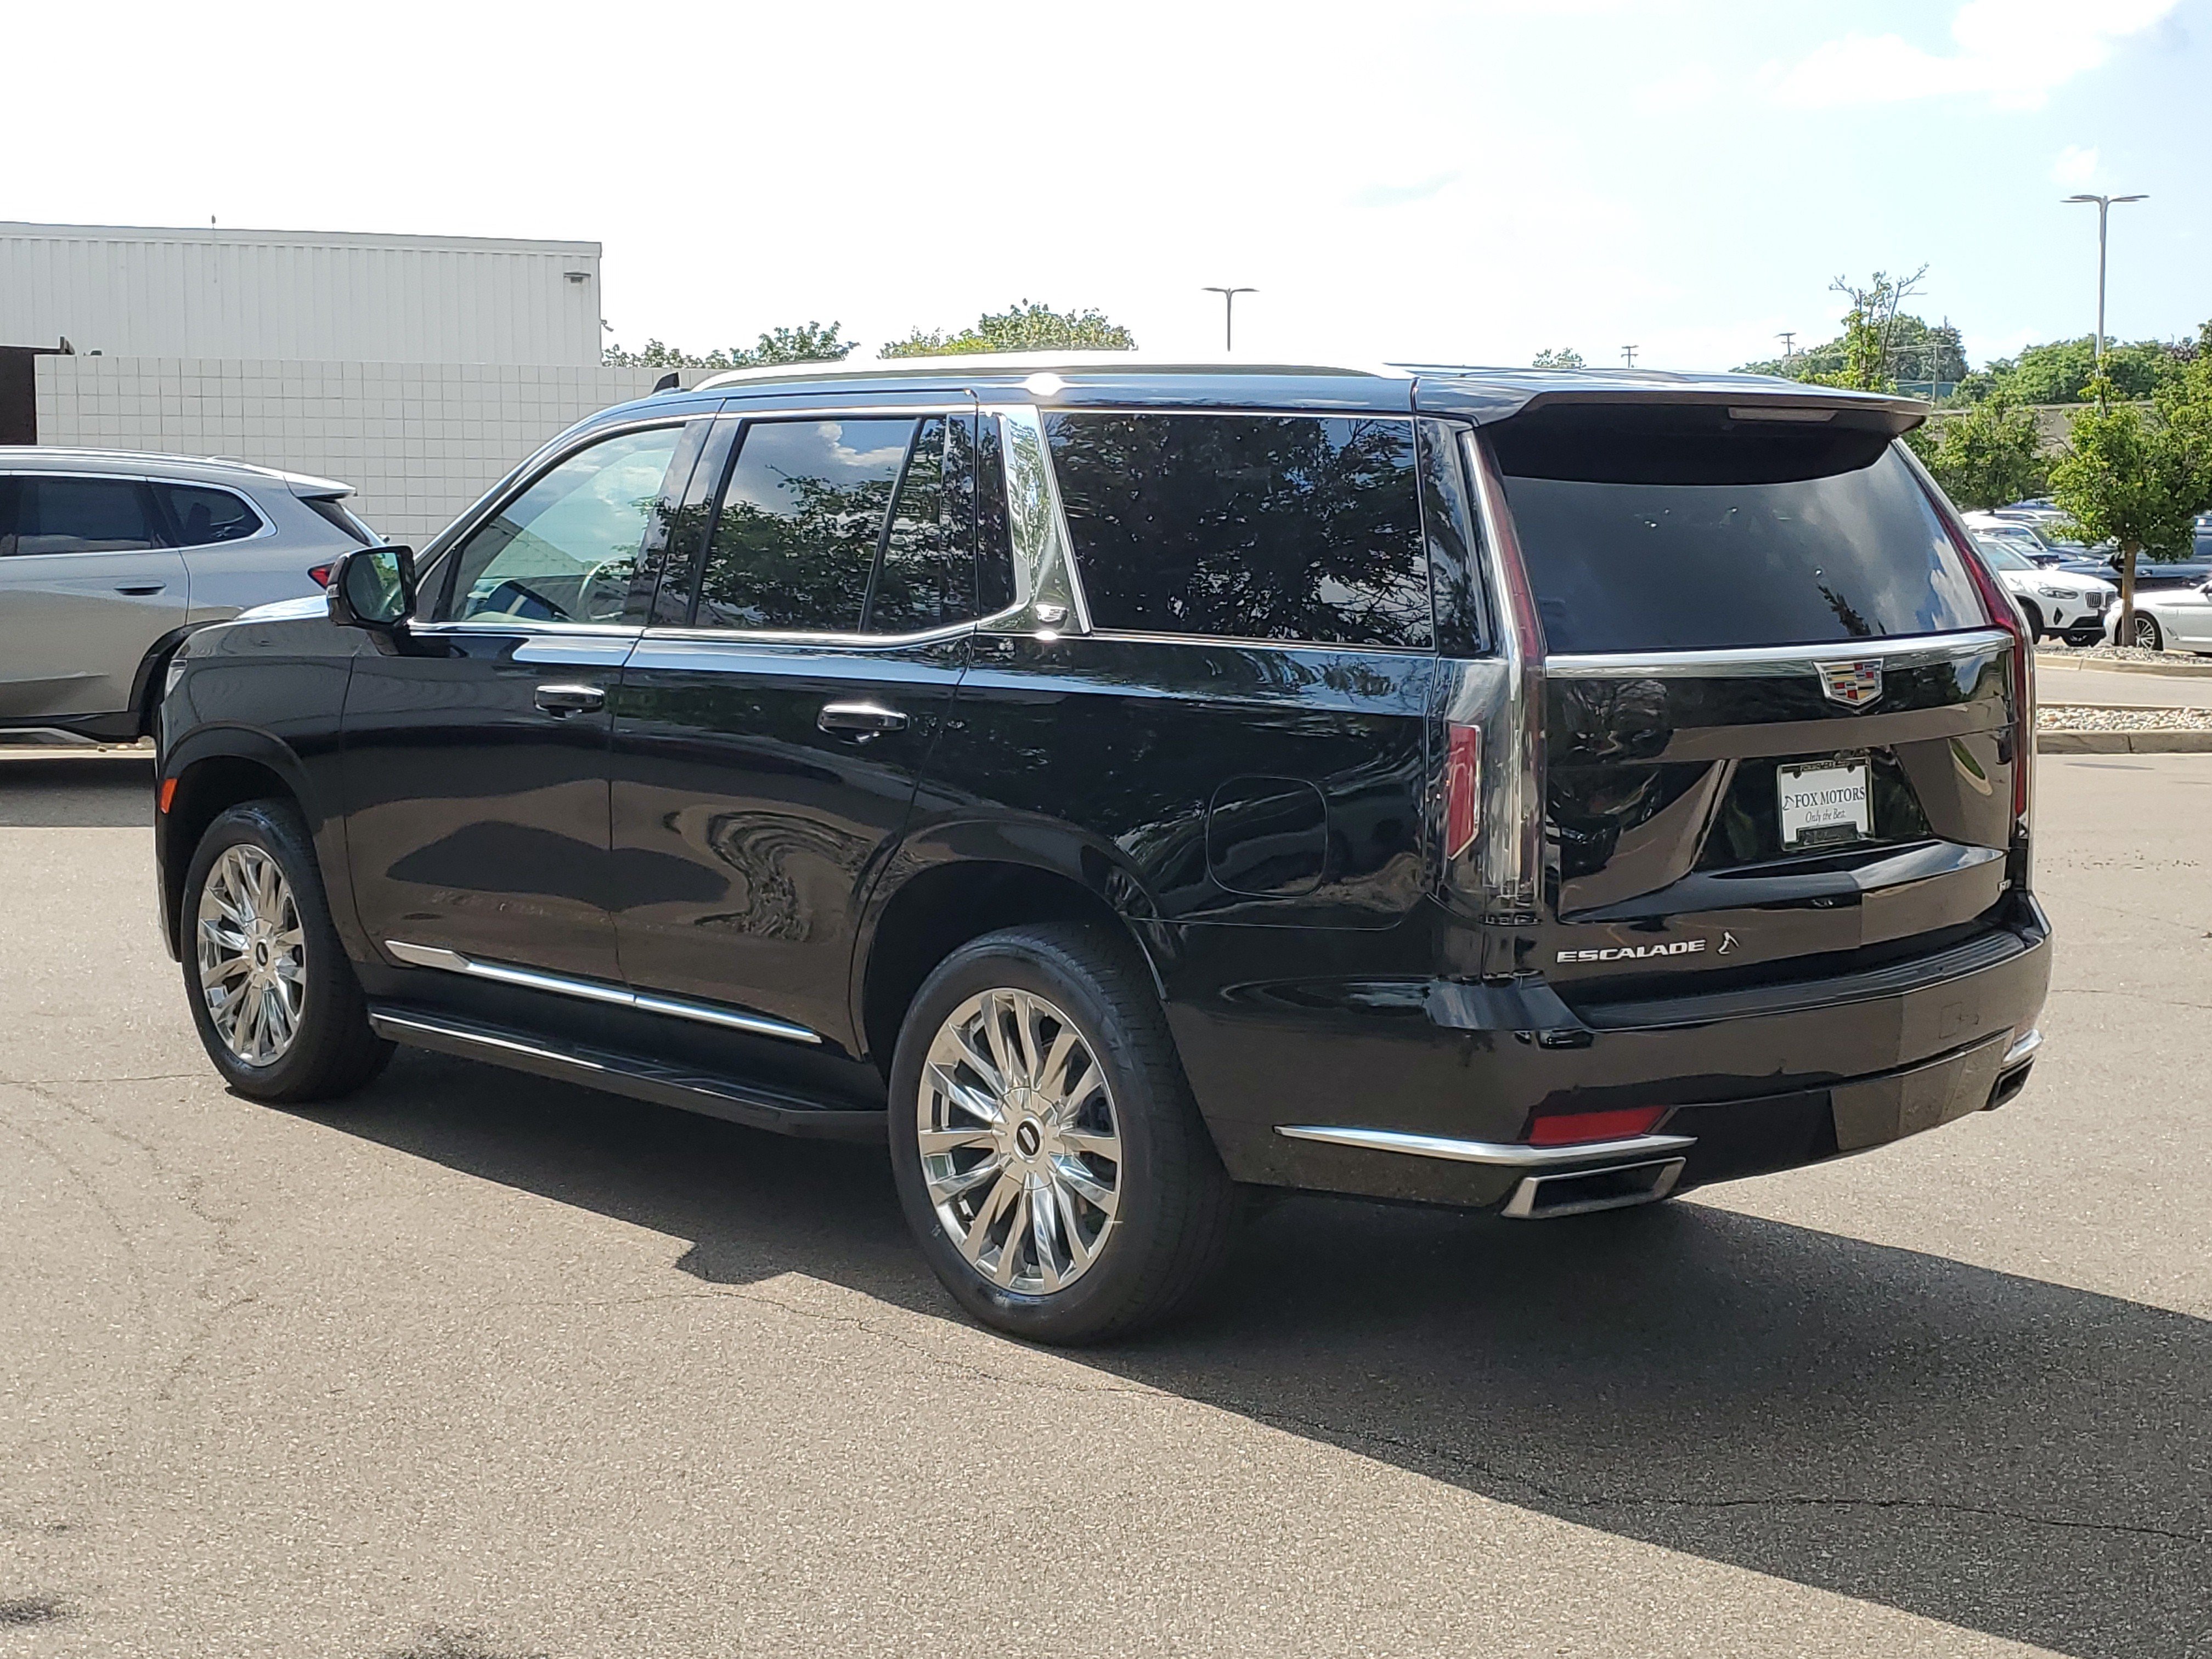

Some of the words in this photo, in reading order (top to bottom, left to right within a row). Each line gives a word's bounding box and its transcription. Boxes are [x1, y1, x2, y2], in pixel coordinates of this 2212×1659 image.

[1795, 793, 1818, 808] FOX
[1820, 787, 1865, 805] MOTORS
[1805, 810, 1820, 822] Only
[1823, 809, 1831, 821] the
[1557, 940, 1706, 963] ESCALADE
